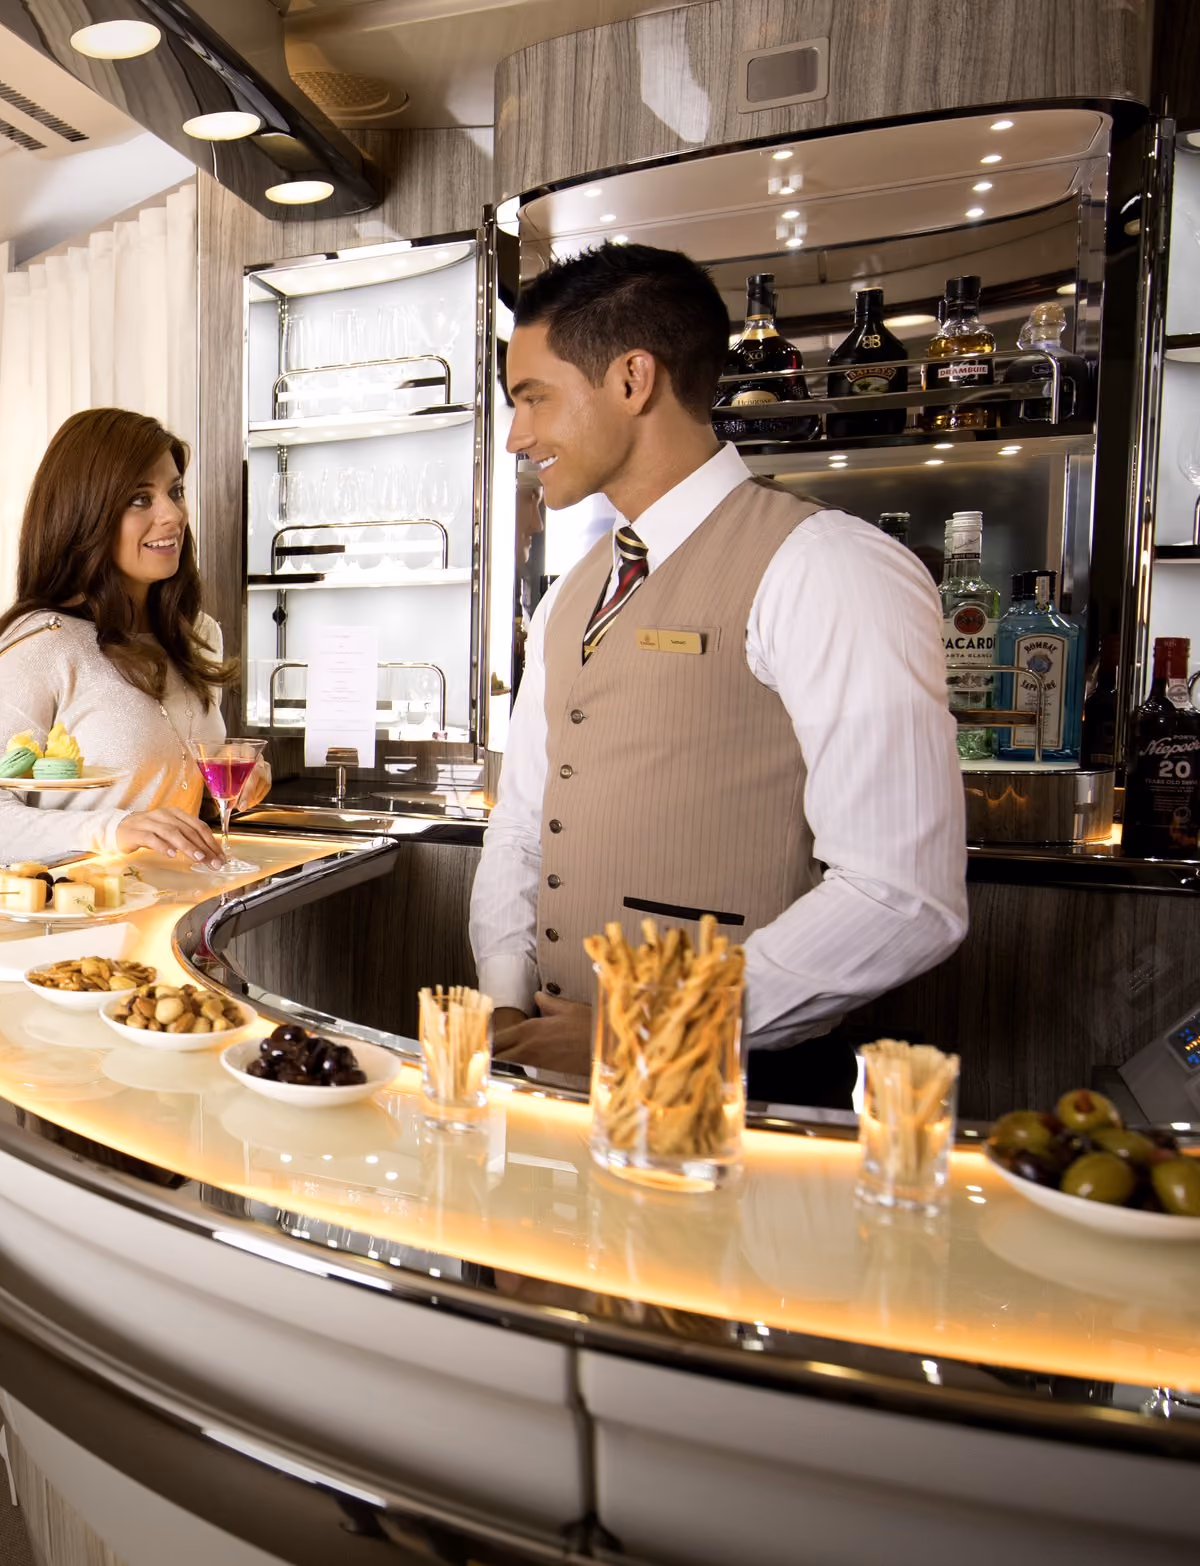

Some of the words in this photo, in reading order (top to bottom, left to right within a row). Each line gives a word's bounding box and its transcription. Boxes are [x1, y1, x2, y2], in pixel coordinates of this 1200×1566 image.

[747, 352, 763, 361] XO
[939, 366, 987, 377] DRAMBUIE
[1023, 640, 1058, 654] BOMBAY
[1020, 679, 1057, 691] SAPPIRE
[1159, 760, 1191, 778] 20
